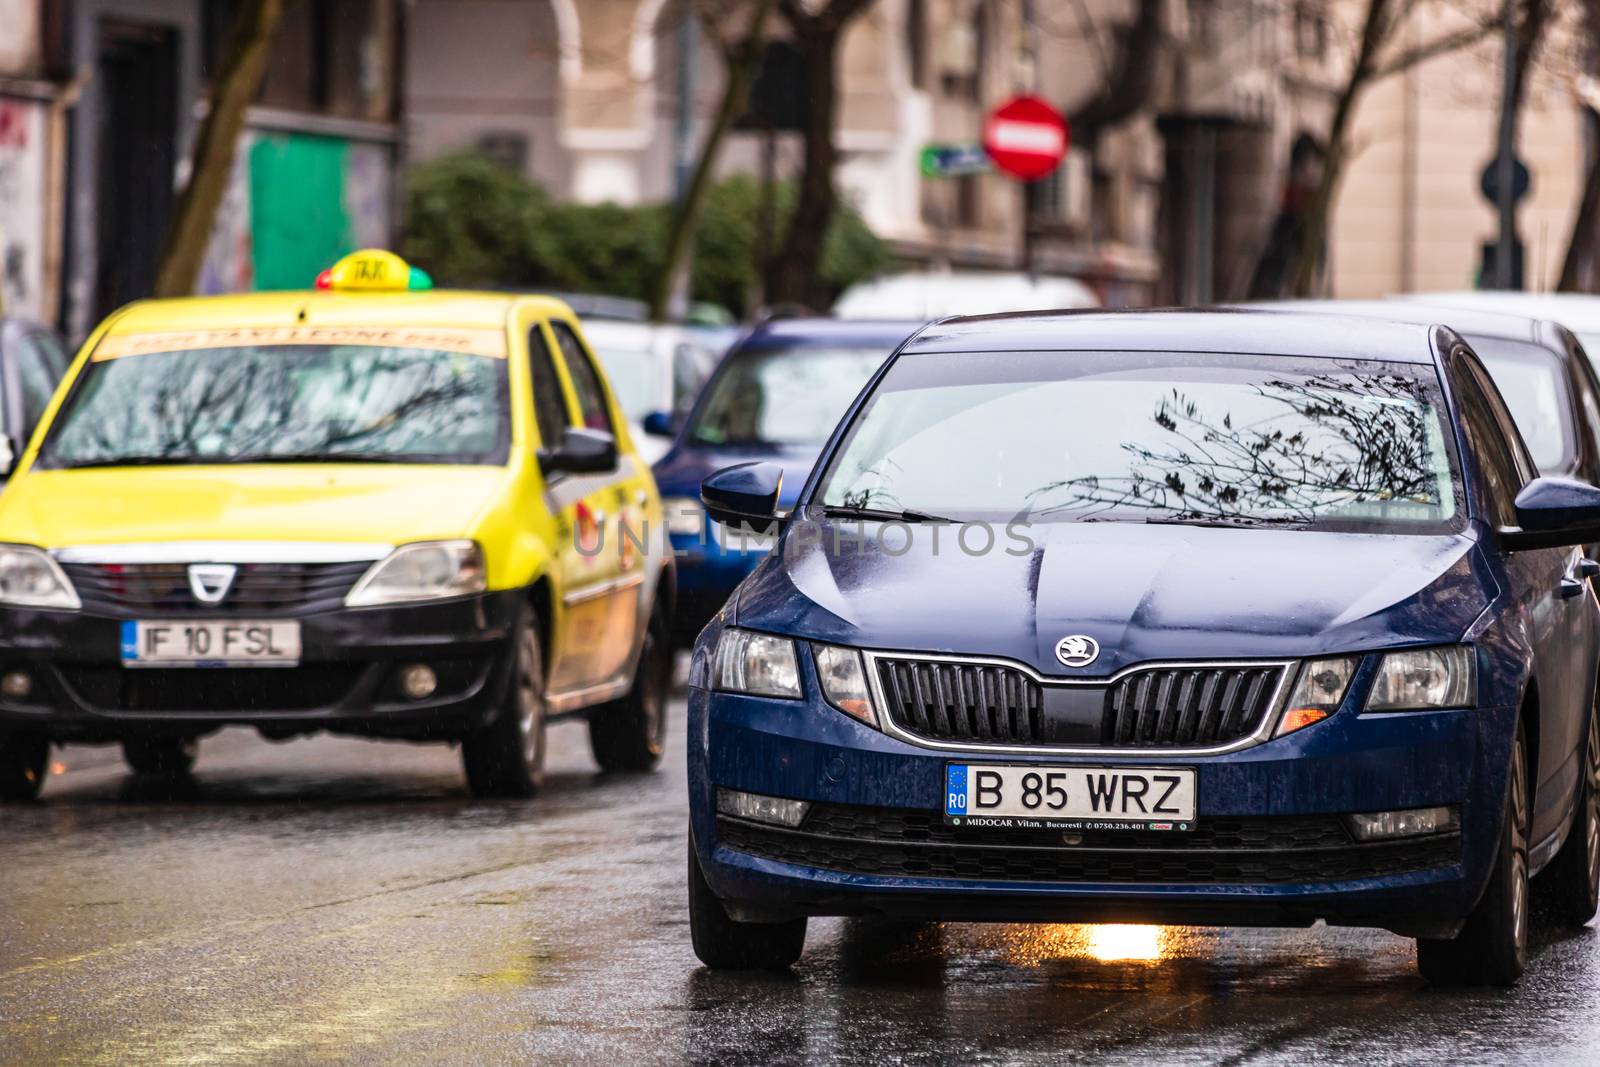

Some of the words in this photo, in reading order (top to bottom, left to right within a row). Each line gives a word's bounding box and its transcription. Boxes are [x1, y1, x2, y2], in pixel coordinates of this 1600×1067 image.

[145, 627, 171, 655] IF
[185, 627, 211, 655] 10
[223, 627, 283, 655] FSL
[949, 793, 966, 808] RO
[976, 771, 1003, 808] B
[1021, 772, 1068, 810] 85
[1086, 774, 1181, 813] WRZ
[966, 818, 1013, 828] MIDOCAR
[1046, 821, 1082, 829] Bucuresti
